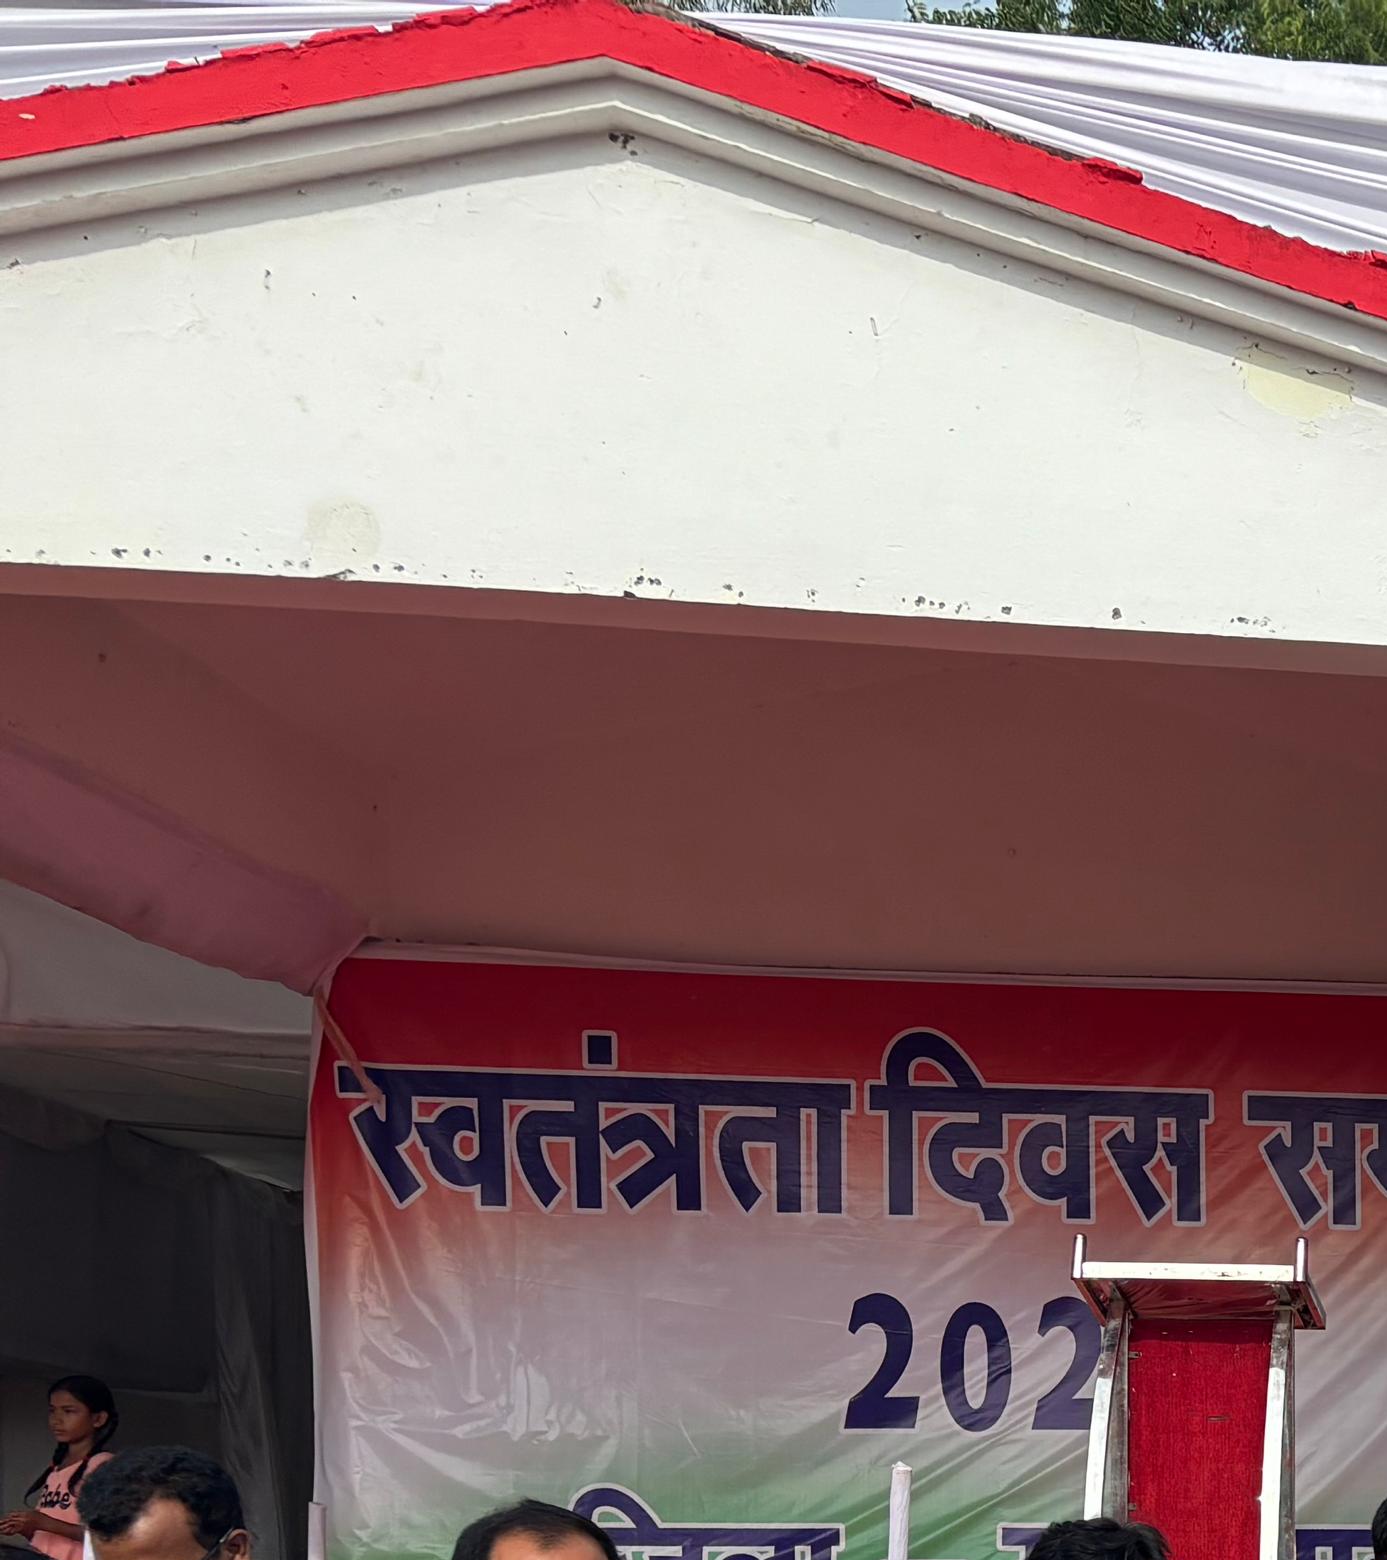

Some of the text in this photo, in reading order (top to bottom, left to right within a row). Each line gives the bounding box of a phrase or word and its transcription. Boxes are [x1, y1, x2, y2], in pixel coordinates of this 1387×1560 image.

[334, 1029, 857, 1216] स्वतंत्रता
[864, 1026, 1214, 1228] दिवस
[841, 1291, 1101, 1434] 202
